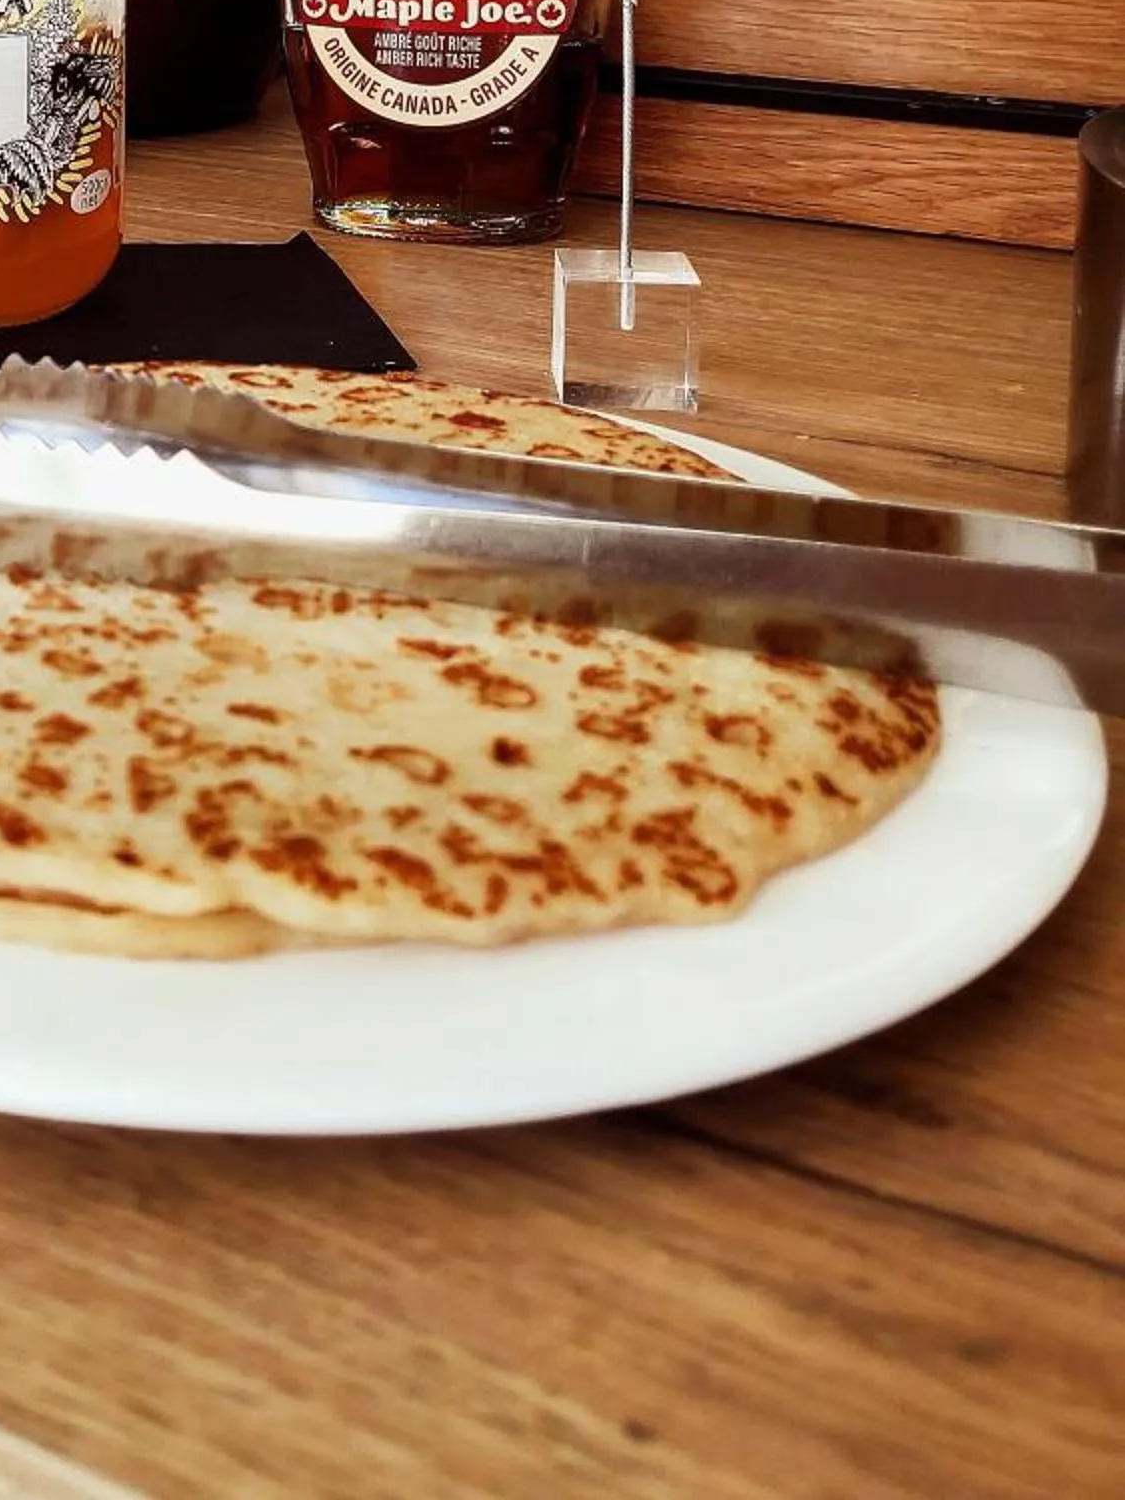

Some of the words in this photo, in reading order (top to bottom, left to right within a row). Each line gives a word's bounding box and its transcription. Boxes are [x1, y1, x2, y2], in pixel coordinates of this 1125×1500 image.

[324, 37, 382, 100] ORIGINE
[381, 81, 458, 115] CANADA
[470, 58, 528, 107] GRADE
[520, 47, 540, 63] A
